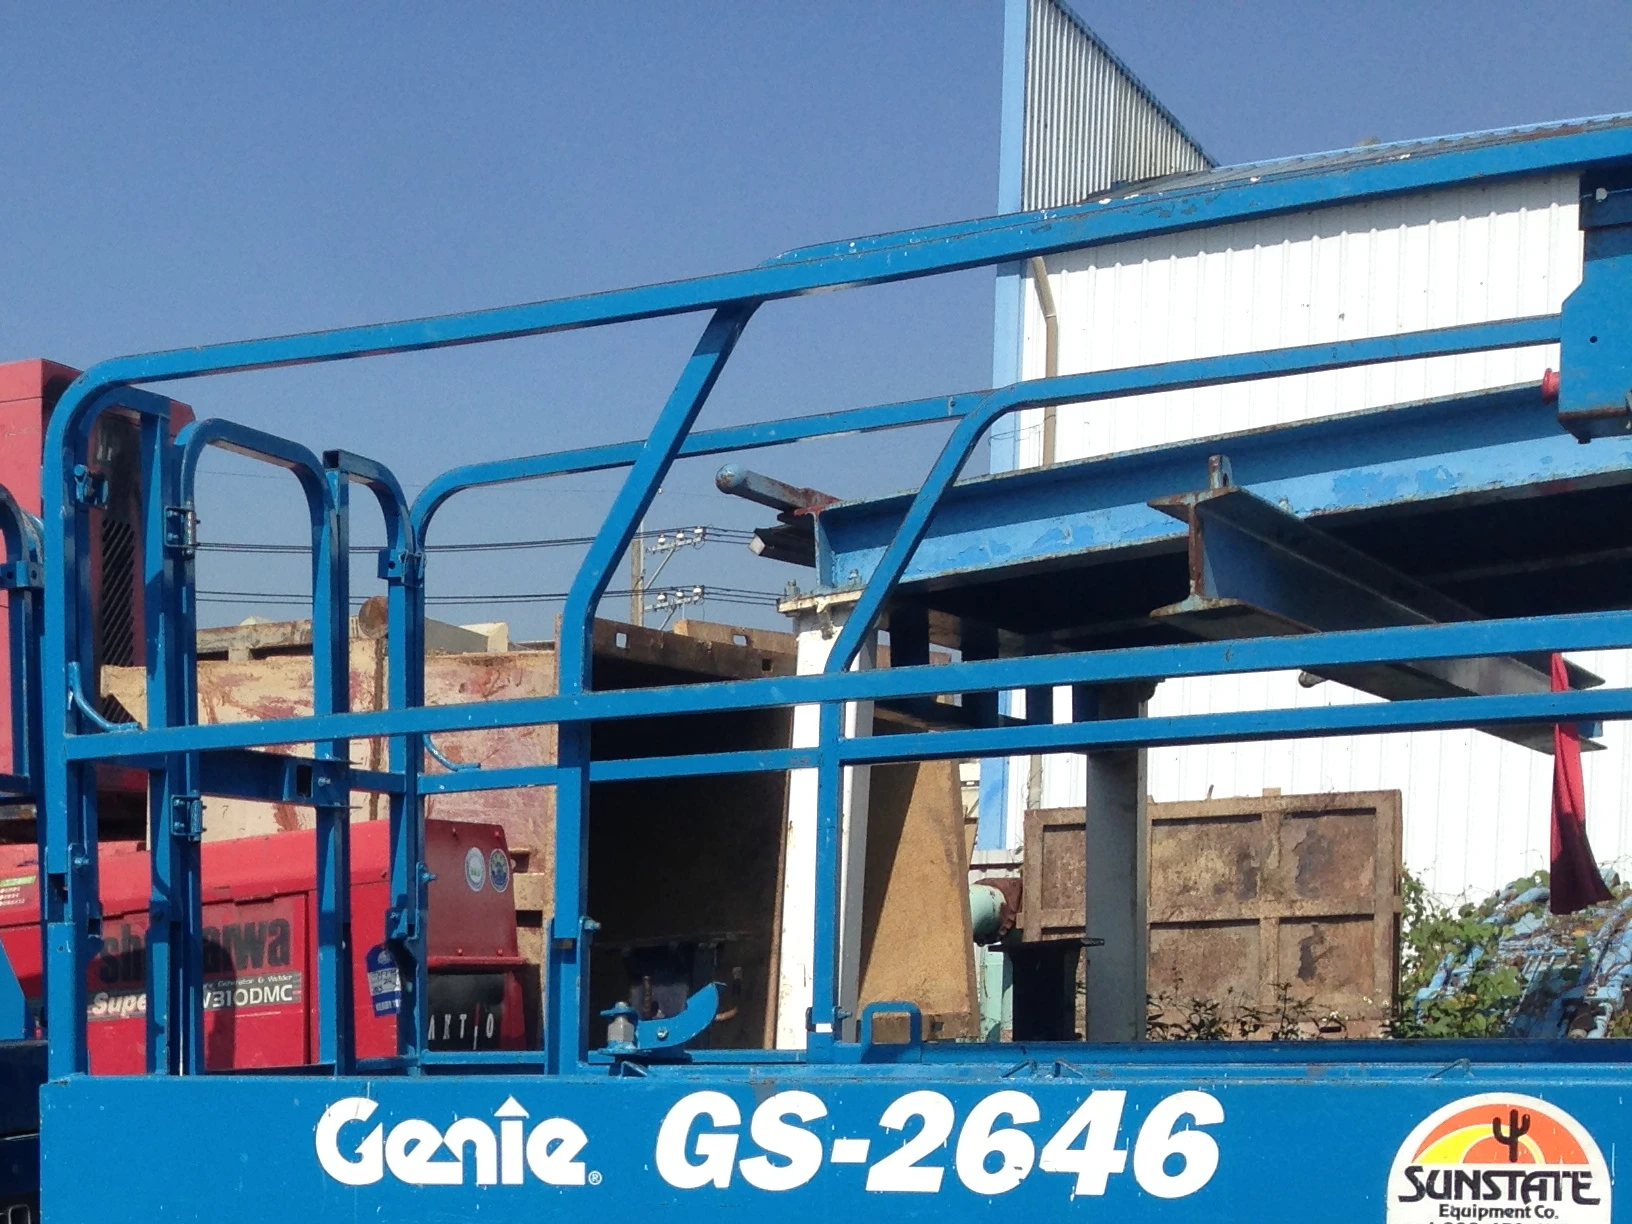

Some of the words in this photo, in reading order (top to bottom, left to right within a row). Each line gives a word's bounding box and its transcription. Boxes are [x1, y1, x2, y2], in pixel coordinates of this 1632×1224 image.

[92, 992, 147, 1016] Supe
[315, 1094, 587, 1186] Genie
[655, 1089, 1226, 1199] GS-2646
[1398, 1165, 1601, 1206] SUNSTATE
[1439, 1203, 1531, 1221] Equipment
[1534, 1204, 1559, 1219] Co.
